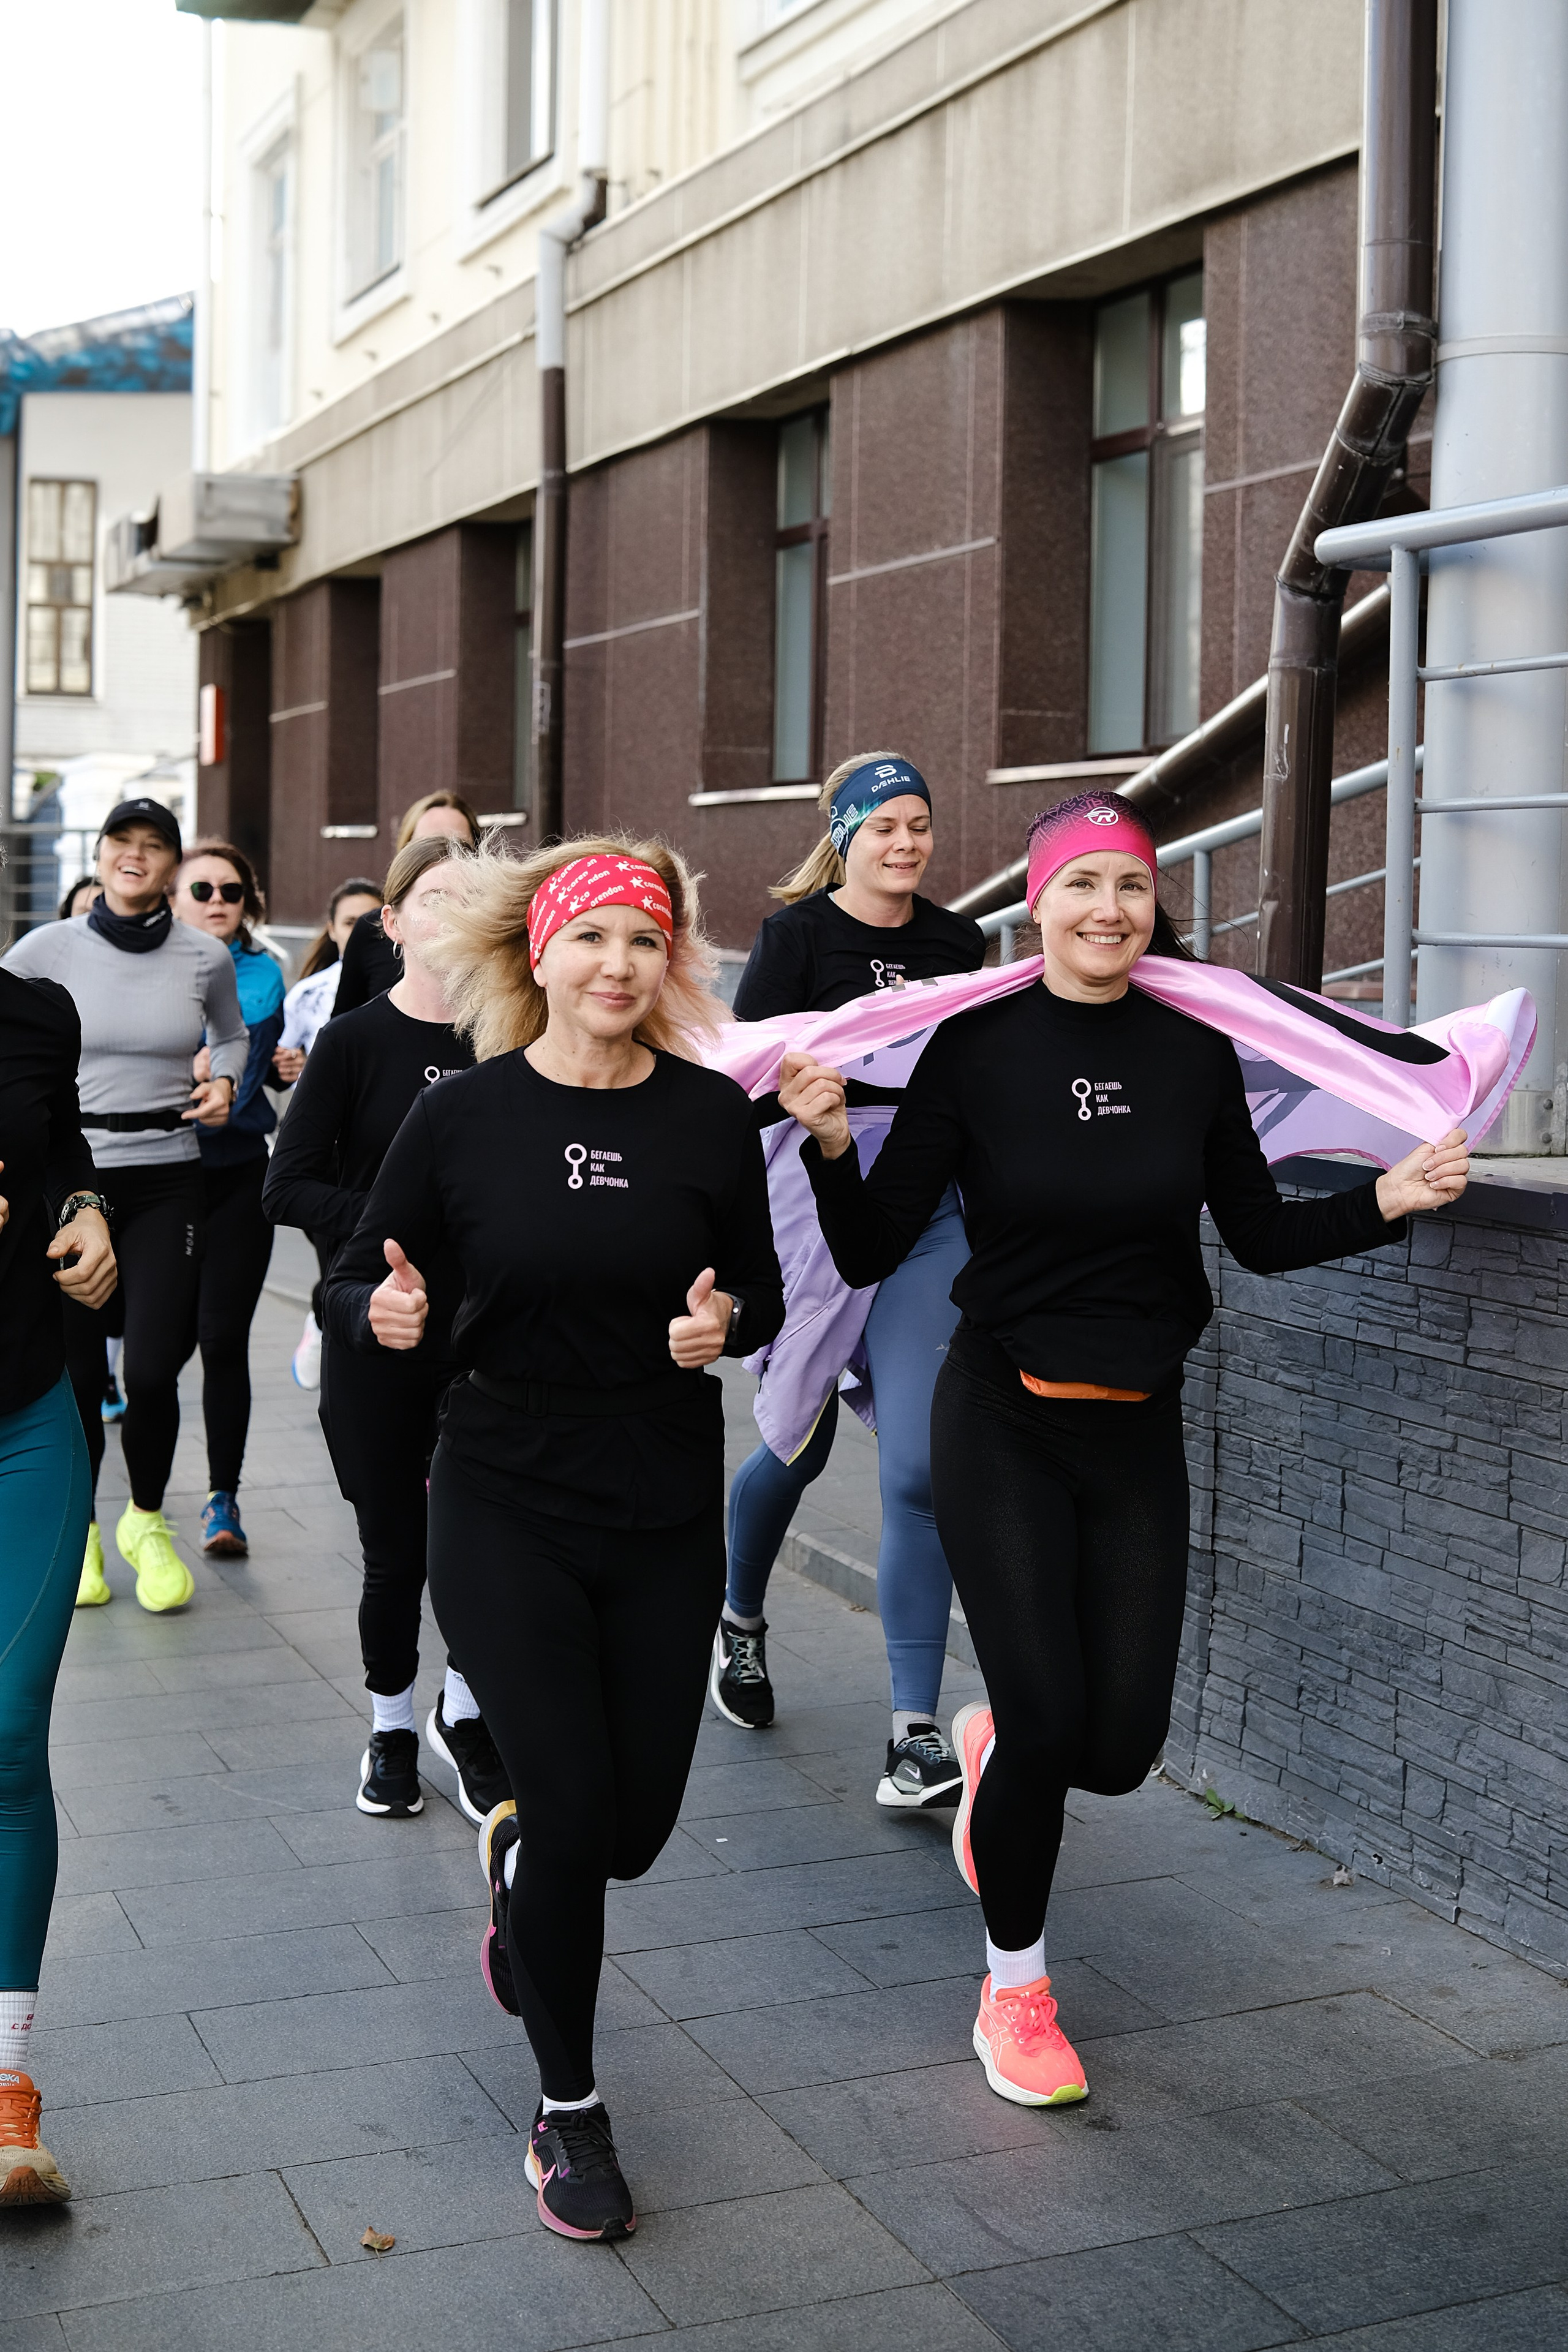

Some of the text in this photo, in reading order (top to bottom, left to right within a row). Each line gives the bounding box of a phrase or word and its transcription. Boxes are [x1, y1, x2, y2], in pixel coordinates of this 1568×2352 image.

[590, 884, 625, 907] orendon
[1095, 1082, 1122, 1091] БЕГАЕШЬ
[1098, 1106, 1131, 1116] ДЕВЧОНКА
[590, 1150, 622, 1162] БЕГАЕШЬ
[590, 1163, 605, 1173] КАК
[589, 1175, 628, 1188] ДЕВЧОНКА
[0, 2073, 20, 2084] OKA
